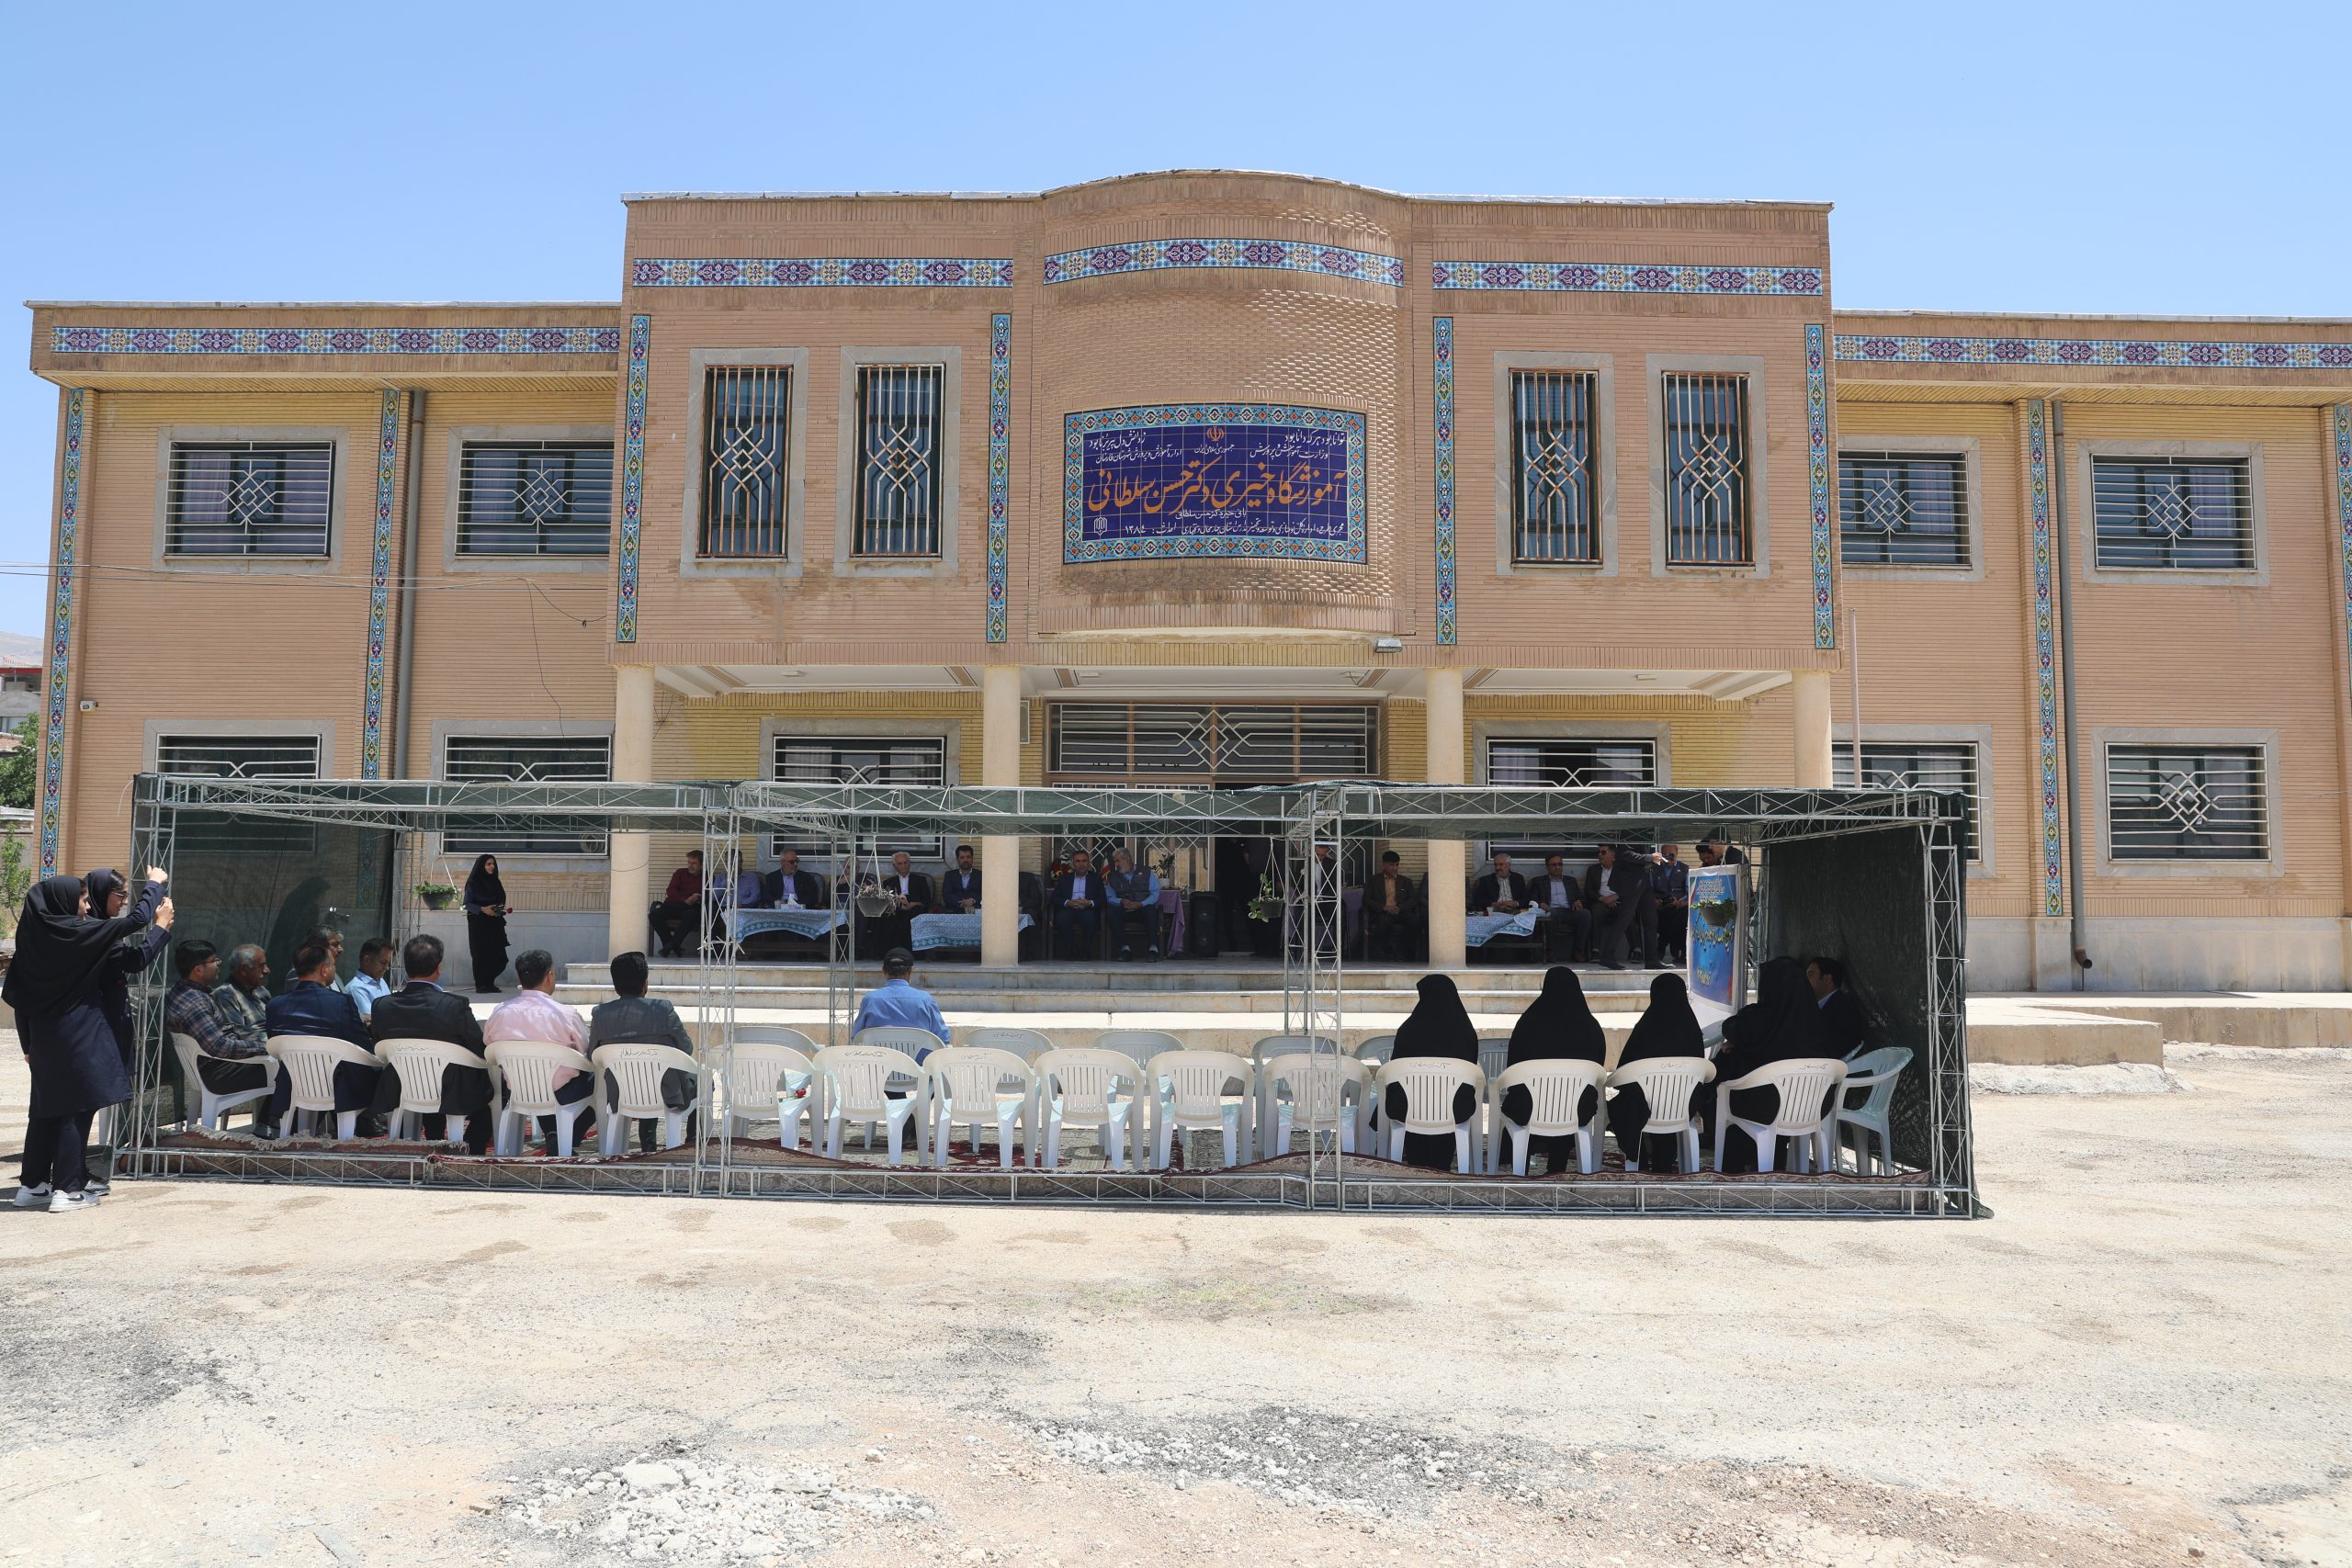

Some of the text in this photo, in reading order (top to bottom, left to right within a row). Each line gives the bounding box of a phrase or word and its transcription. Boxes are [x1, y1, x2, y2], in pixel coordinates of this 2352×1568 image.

[1114, 434, 1125, 448] دل
[1125, 430, 1141, 447] دانش
[1285, 433, 1295, 443] بود
[1295, 429, 1306, 443] دانا
[1321, 434, 1332, 446] بود
[1332, 432, 1345, 446] توانا
[1089, 439, 1099, 450] بود
[1215, 445, 1235, 455] جمهوری
[1250, 442, 1276, 459] پرورش
[1275, 443, 1302, 457] آموزش
[1130, 446, 1148, 462] پرورش
[1149, 445, 1173, 459] آموزش
[1167, 449, 1182, 457] اداره
[1298, 449, 1329, 459] وزارت
[1168, 456, 1221, 515] دکتر
[1266, 461, 1346, 505] آموزشگاه
[1088, 469, 1156, 512] سلطانی
[1144, 470, 1193, 513] حسن
[1175, 509, 1195, 519] سلطانی
[1195, 511, 1211, 519] حسن
[1234, 507, 1246, 518] بانی
